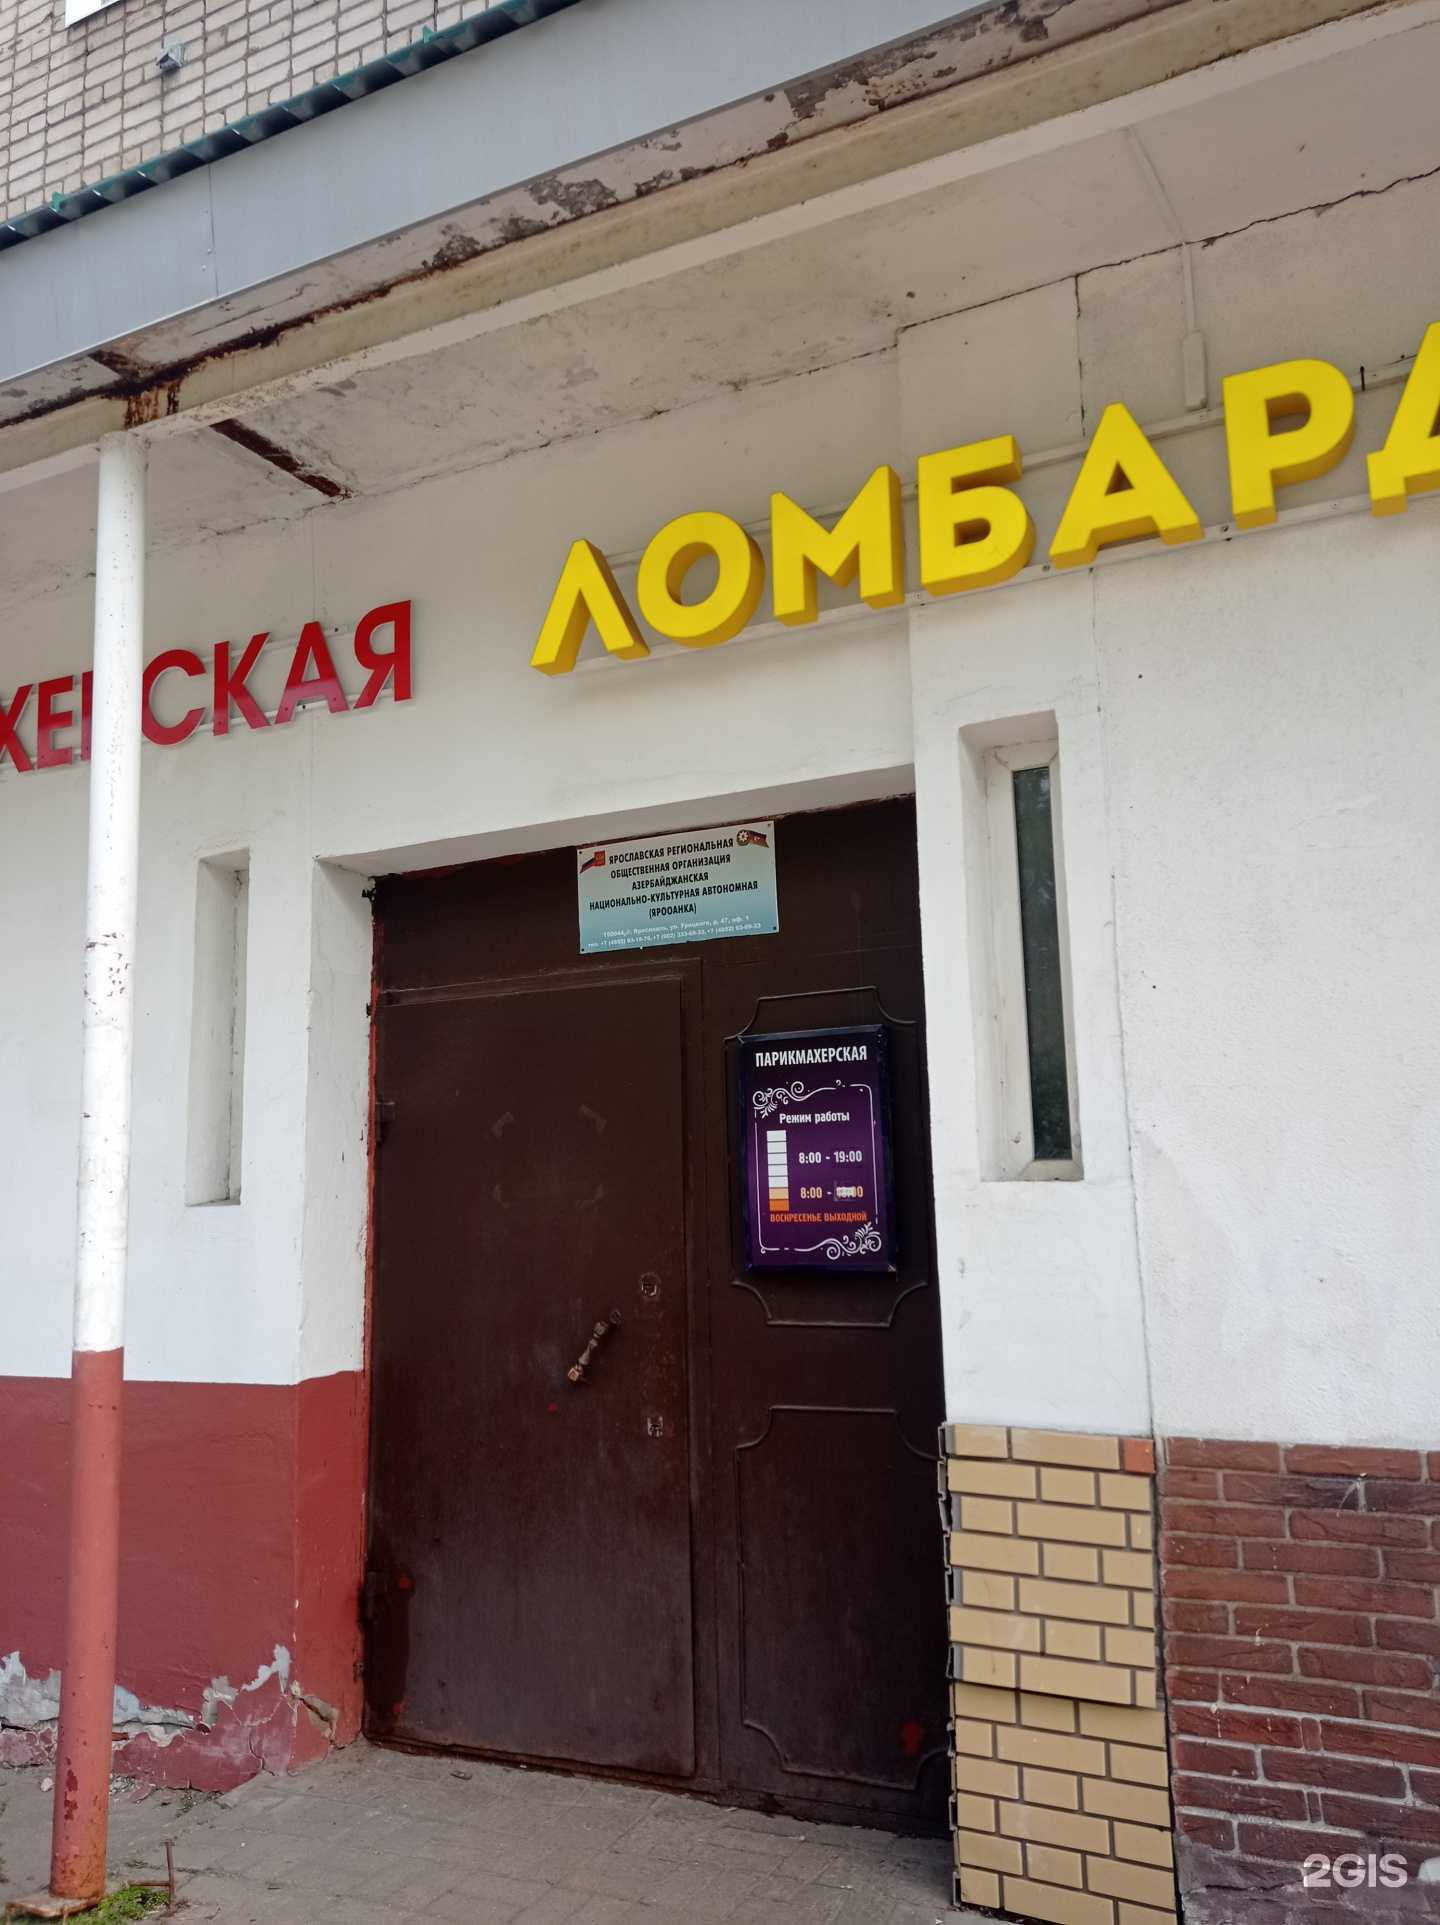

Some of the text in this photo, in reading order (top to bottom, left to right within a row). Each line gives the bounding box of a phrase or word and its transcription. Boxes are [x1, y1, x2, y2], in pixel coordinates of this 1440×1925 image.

[0, 599, 413, 774] ХЕСКАЯ
[608, 838, 734, 865] ЯРОСЛАВСКАЯ РЕГИОНАЛЬНАЯ
[610, 854, 731, 879] ОБЩЕСТВЕННАЯ ОРГАНИЗАЦИЯ
[632, 872, 709, 891] АЗЕРБАЙДЖАНСКАЯ
[589, 880, 758, 911] НАЦИОНАЛЬНО-КУЛЬТУРНАЯ АВТОНОМНАЯ
[648, 903, 697, 920] (ЯРООАНКА)
[755, 1045, 867, 1068] ПАРИКМАХЕРСКАЯ
[779, 1111, 850, 1125] Режим работы
[798, 1151, 822, 1164] 8:00
[833, 1150, 863, 1164] 19:00
[800, 1186, 823, 1199] 8:00
[770, 1210, 868, 1223] ВОСКРЕСЕНЬЕ ВЫХОДНОЙ
